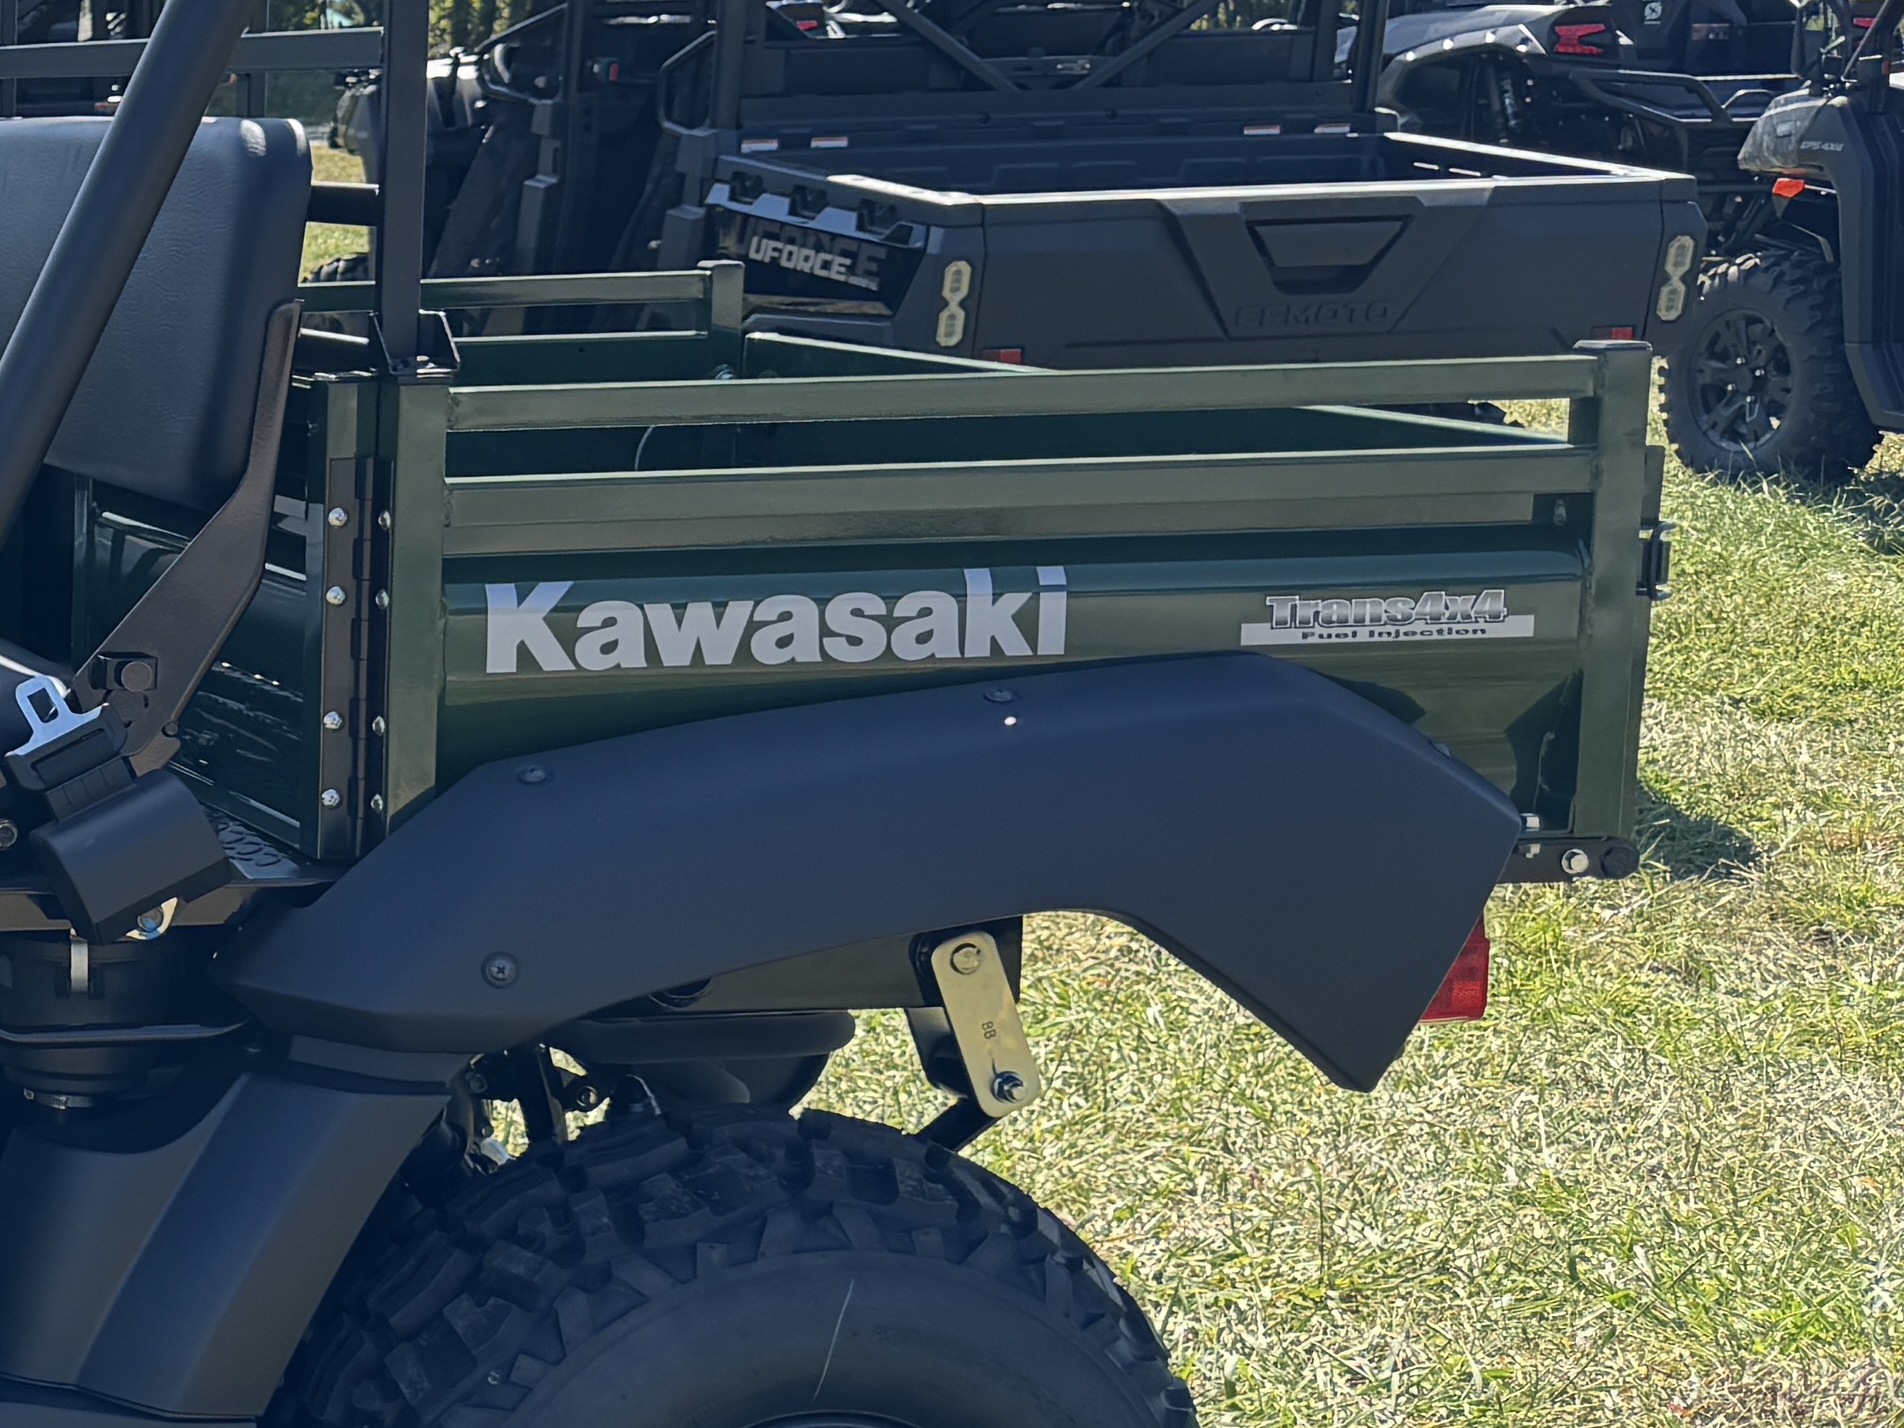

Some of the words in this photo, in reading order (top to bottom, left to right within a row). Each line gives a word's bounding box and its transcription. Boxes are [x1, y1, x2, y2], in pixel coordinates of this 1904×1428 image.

[748, 236, 852, 281] UFORCE
[485, 566, 1067, 673] Kawasaki
[1266, 589, 1507, 629] Trans4x4
[1302, 629, 1358, 640] Fuel
[1369, 626, 1487, 640] Injection
